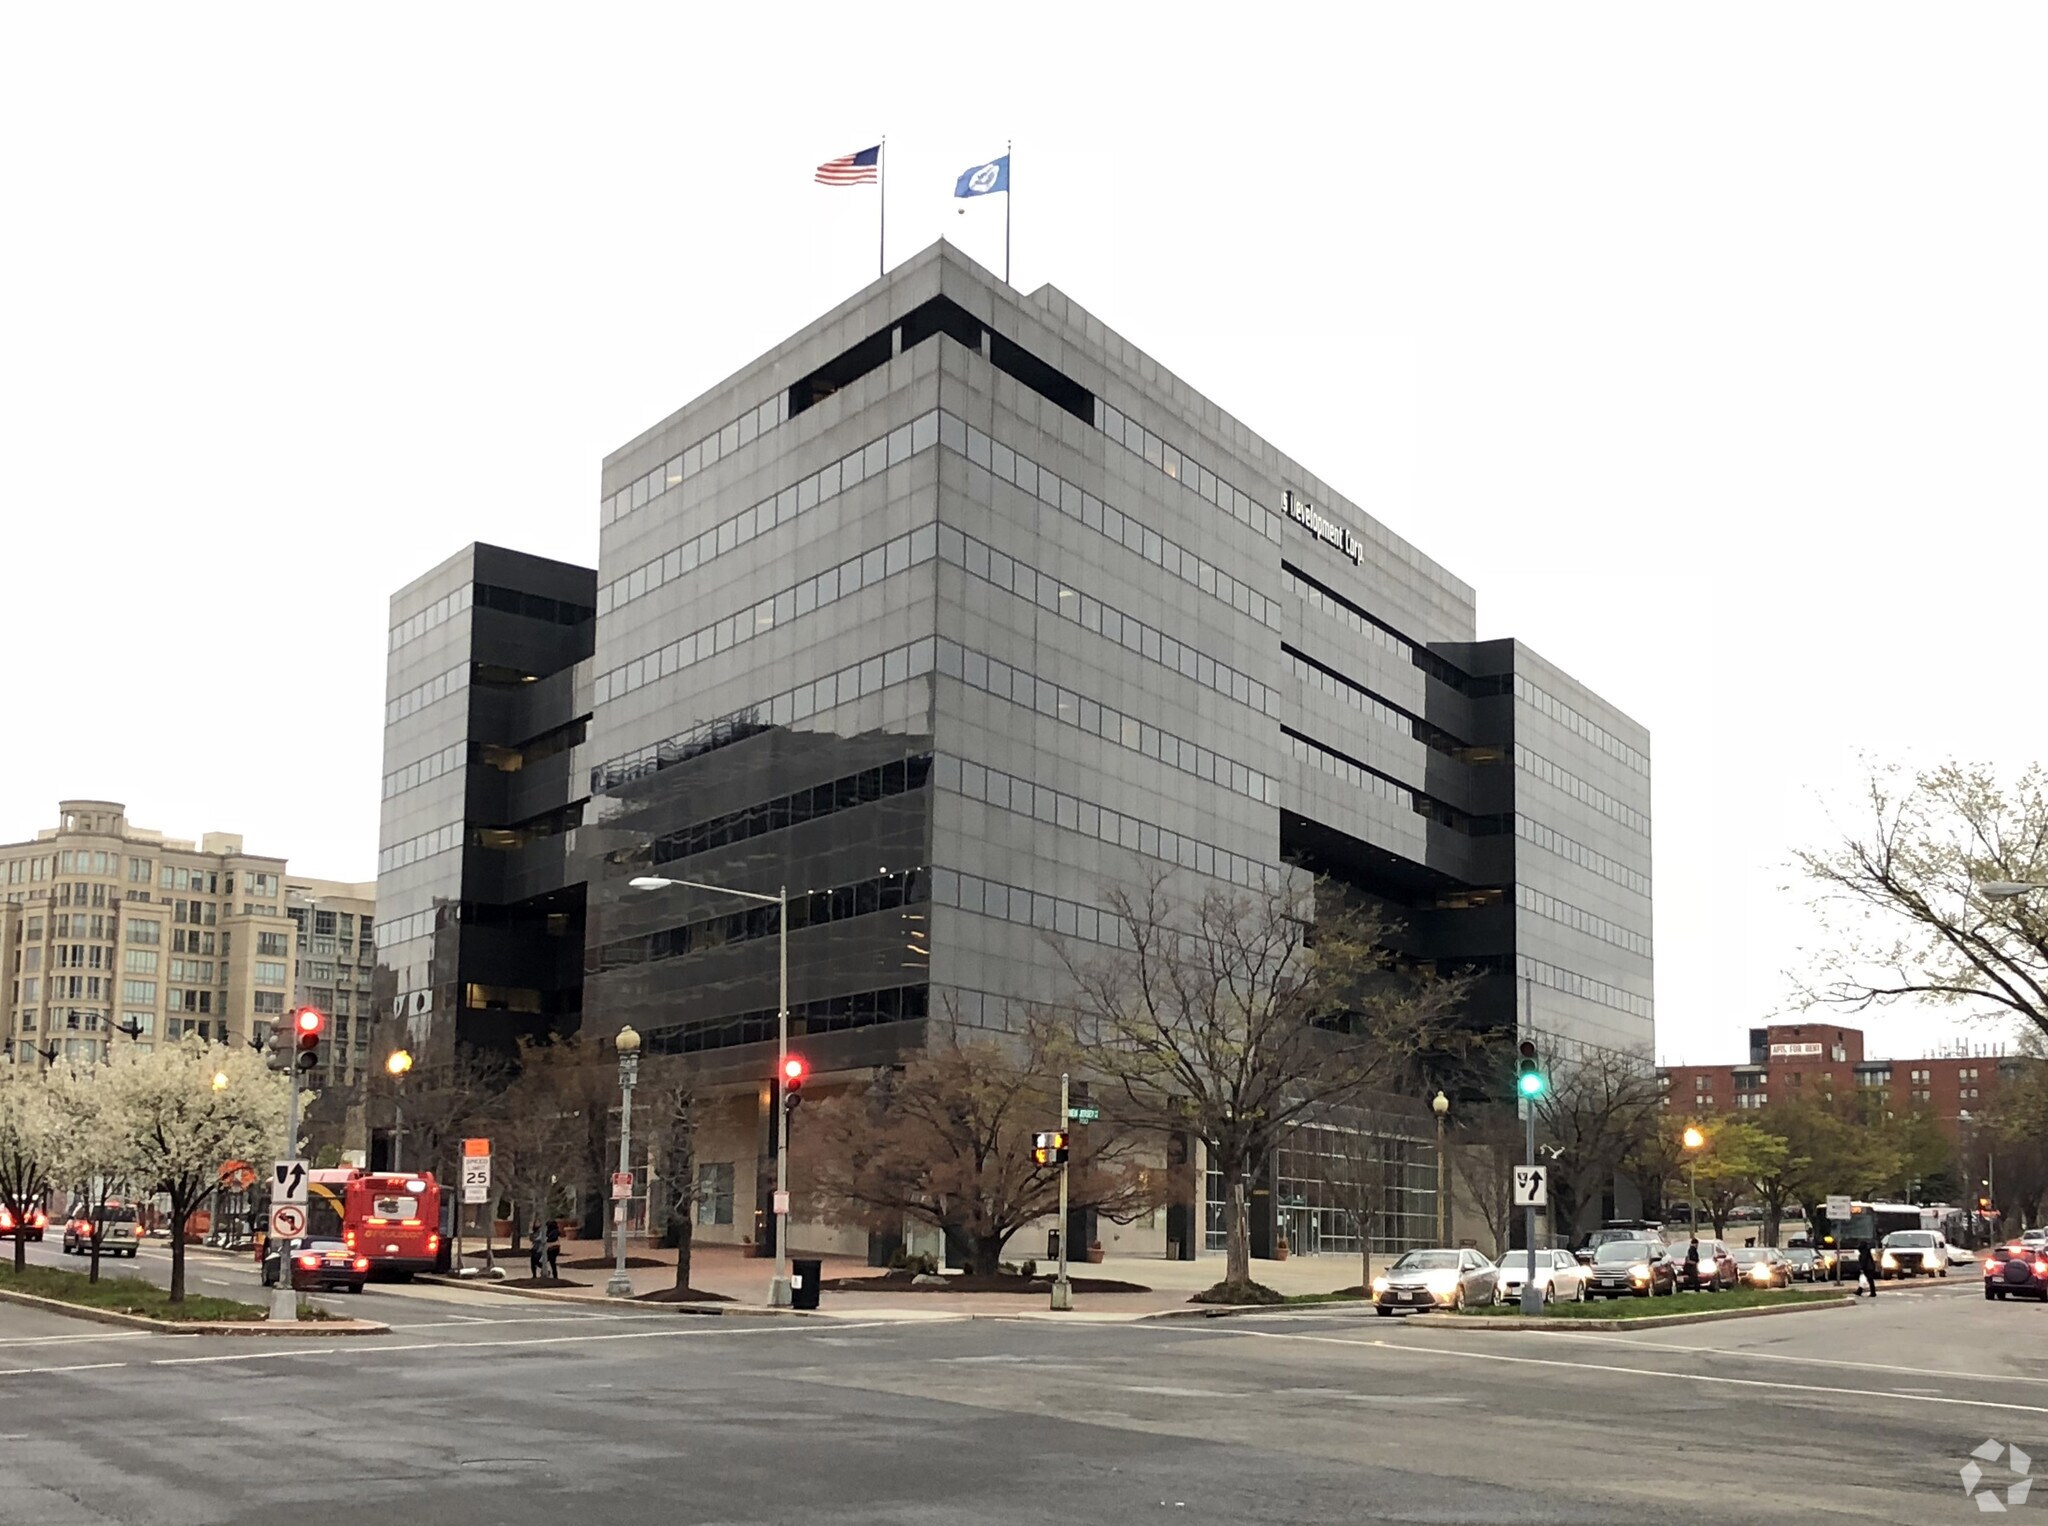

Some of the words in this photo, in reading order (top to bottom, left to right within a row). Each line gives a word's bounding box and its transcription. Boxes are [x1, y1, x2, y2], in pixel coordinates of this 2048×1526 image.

[1290, 493, 1343, 549] Development
[1790, 1044, 1802, 1053] FOR
[1805, 1044, 1820, 1052] RENT
[466, 1172, 487, 1184] 25
